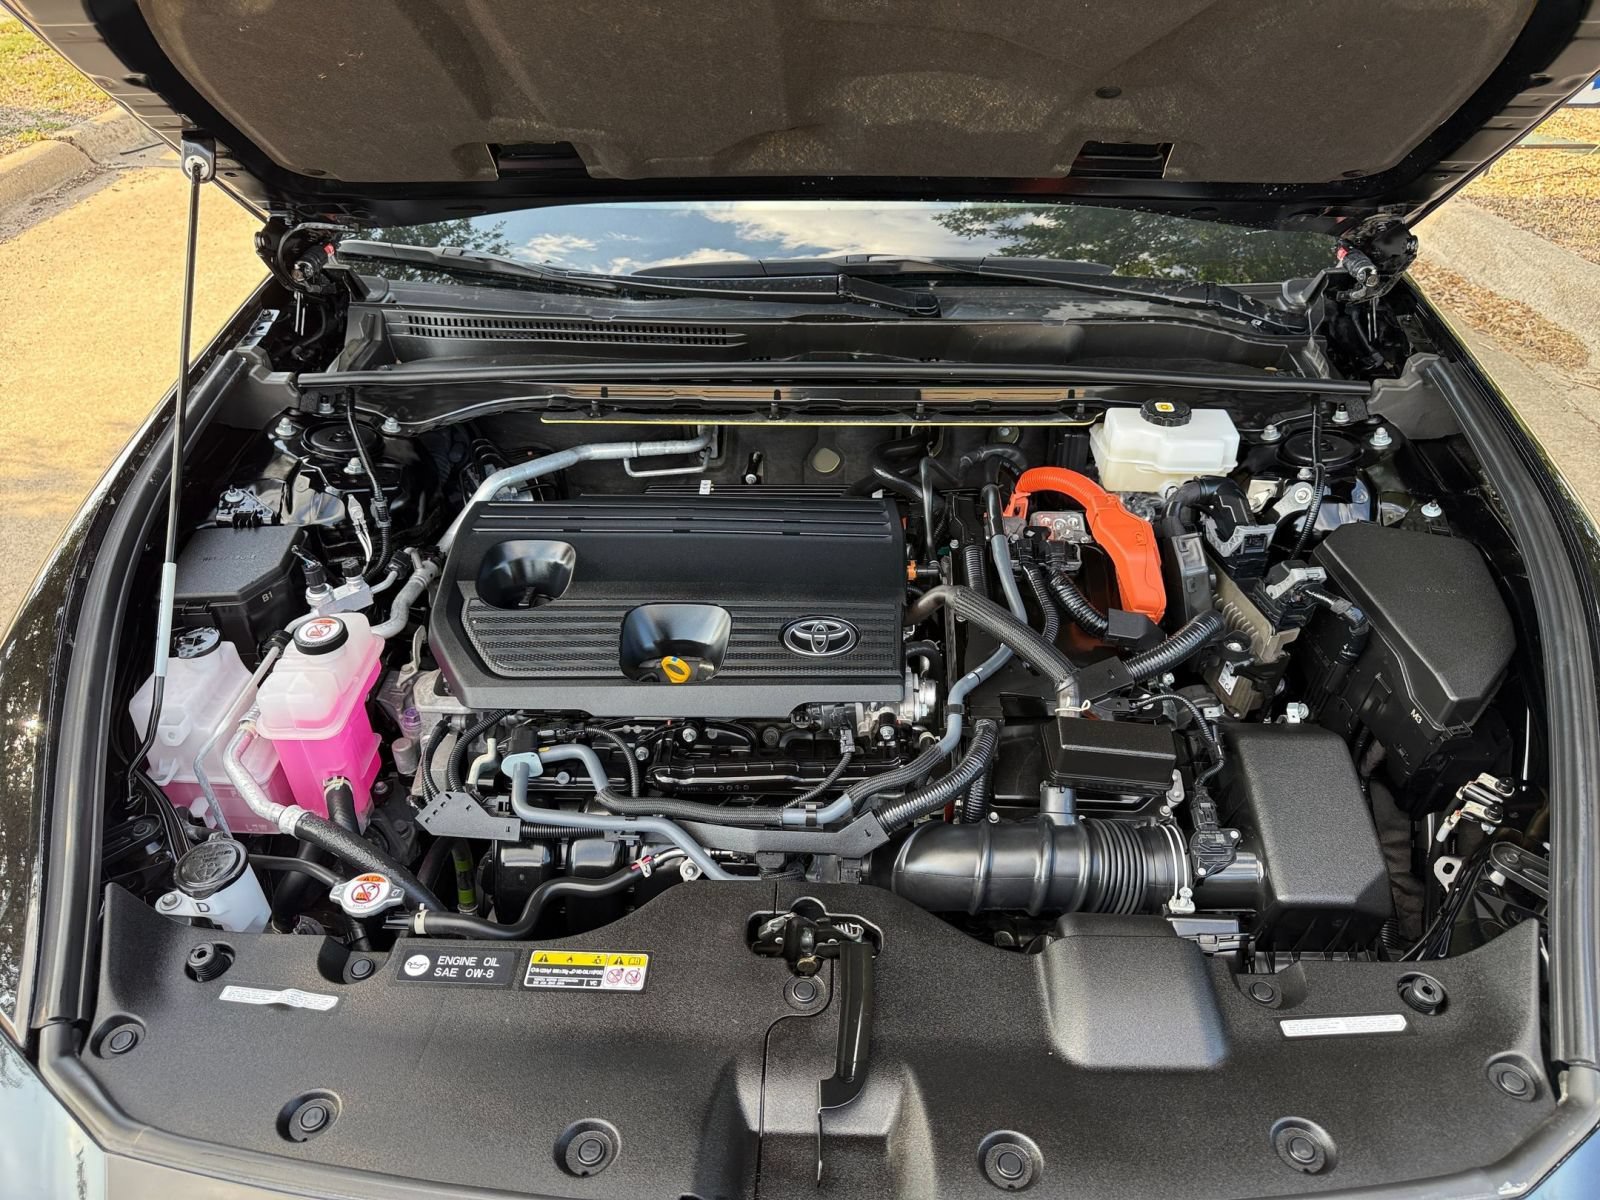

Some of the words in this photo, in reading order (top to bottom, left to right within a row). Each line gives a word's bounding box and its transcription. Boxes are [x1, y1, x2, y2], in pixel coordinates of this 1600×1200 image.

[261, 591, 273, 603] B1
[437, 955, 478, 966] ENGINE
[483, 957, 500, 967] OIL
[433, 967, 459, 977] SAE
